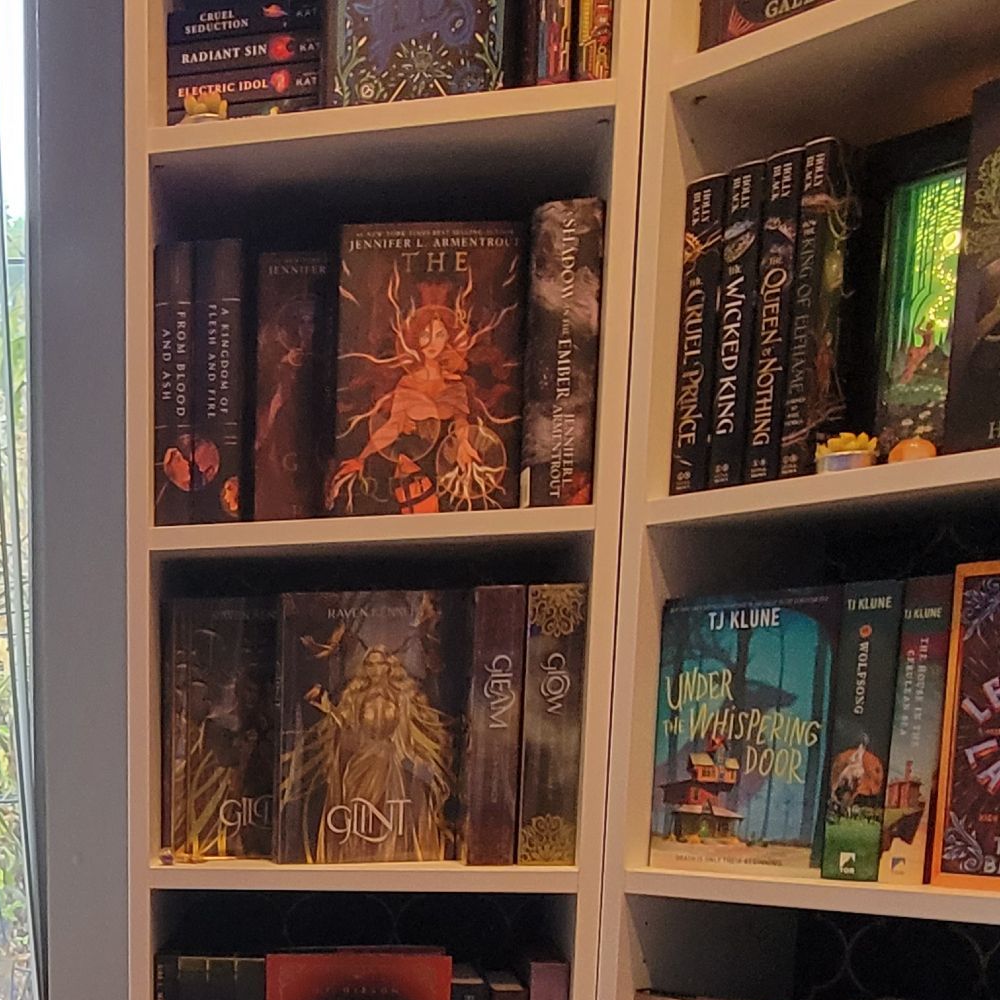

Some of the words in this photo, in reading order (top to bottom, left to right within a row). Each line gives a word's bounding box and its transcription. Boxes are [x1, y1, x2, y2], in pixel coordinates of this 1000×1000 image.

[184, 18, 249, 35] SEDUCTION
[199, 9, 234, 22] CRUEL
[181, 47, 241, 64] RADIANT
[244, 43, 268, 57] SIN
[239, 78, 269, 92] IDOL
[740, 174, 752, 209] HOLLY
[781, 162, 793, 198] HOLLY
[350, 238, 411, 252] JENNIFER
[433, 235, 520, 249] ARMENTROUT
[401, 250, 470, 273] THE
[560, 219, 576, 299] SHADOW
[207, 304, 218, 345] FLESH
[220, 308, 230, 316] A
[684, 288, 706, 365] CRUEL
[720, 275, 747, 371] WICKED
[760, 267, 788, 346] QUEEN
[161, 329, 172, 362] AND
[176, 311, 187, 354] FROM
[207, 353, 217, 382] AND
[220, 323, 230, 390] KINGDOM
[556, 338, 573, 400] EMBER
[161, 371, 172, 400] ASH
[175, 363, 186, 417] BLOOD
[219, 397, 229, 414] OF
[677, 361, 704, 449] PRINCE
[715, 375, 738, 436] KING
[752, 356, 784, 447] NOTHING
[550, 404, 563, 499] ARMENTROUT
[562, 413, 576, 478] JENNIFER
[327, 607, 369, 619] RAVEN
[708, 611, 726, 631] TJ
[730, 607, 782, 630] KLUNE
[847, 599, 856, 611] TJ
[857, 596, 893, 611] KLUNE
[913, 607, 943, 619] KLUNE
[918, 637, 930, 662] THE
[484, 654, 516, 729] GLEAM
[540, 652, 571, 715] GLOW
[665, 666, 735, 712] UNDER
[853, 640, 869, 715] WOLFSONG
[744, 745, 807, 785] DOOR
[326, 797, 412, 845] GLINT
